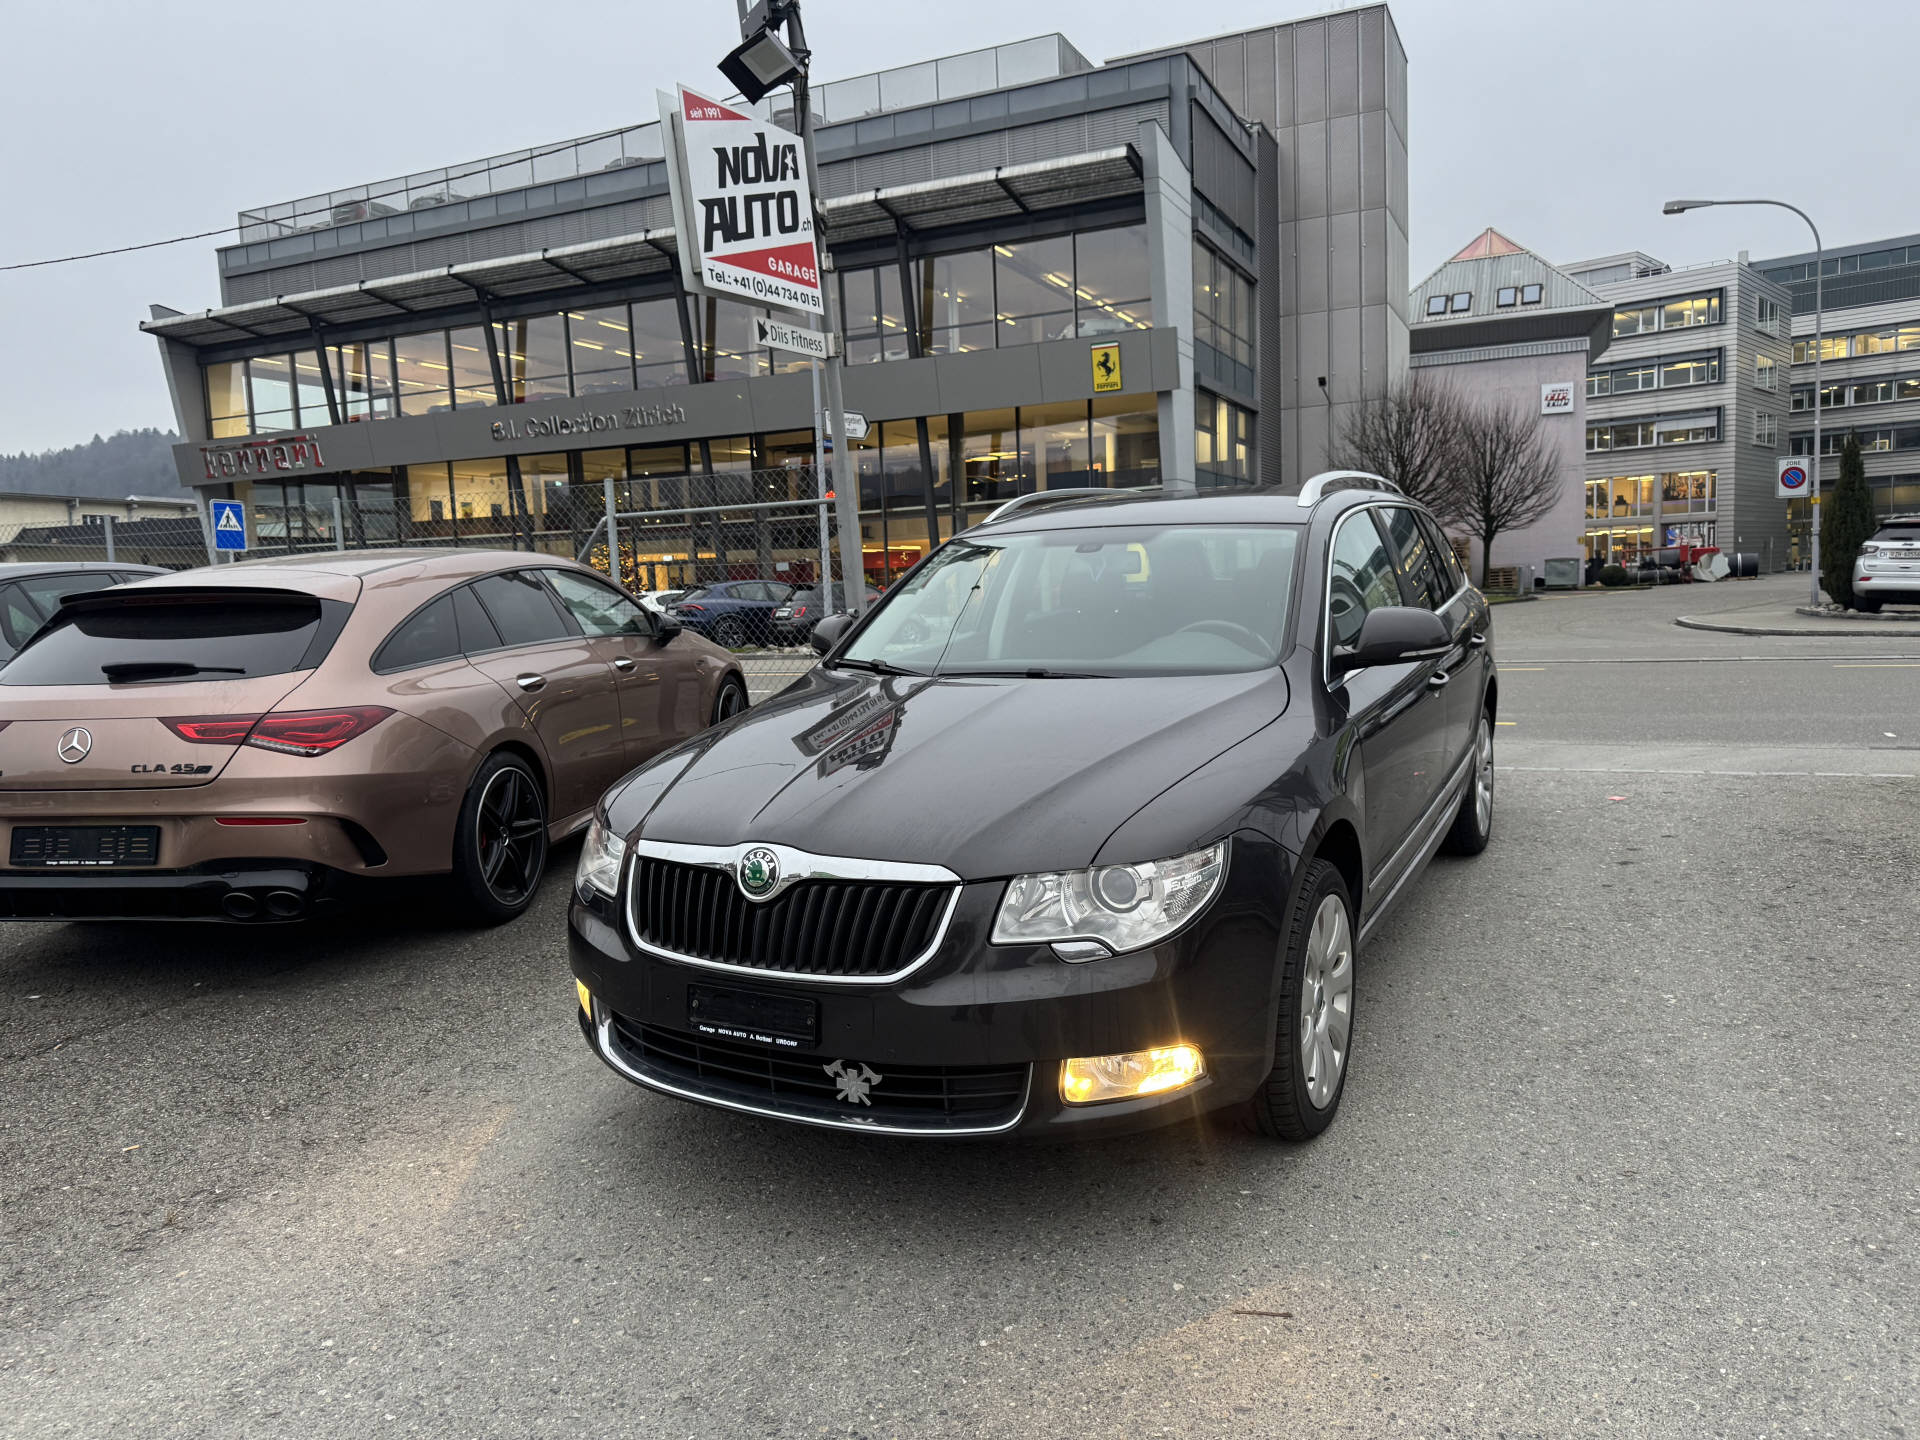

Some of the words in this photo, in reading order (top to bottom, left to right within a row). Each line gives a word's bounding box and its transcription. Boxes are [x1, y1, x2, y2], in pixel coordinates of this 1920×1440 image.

[689, 107, 703, 119] seit
[704, 107, 722, 119] 1991
[712, 132, 800, 189] NOVA
[697, 190, 800, 253] AUTO
[768, 257, 816, 283] GARAGE
[708, 268, 732, 285] Tel.:
[733, 277, 751, 290] +41
[781, 288, 798, 302] 734
[800, 292, 810, 305] 01
[811, 296, 820, 308] 51
[770, 325, 789, 345] Diis
[791, 330, 822, 352] Fitness
[525, 411, 618, 438] Collection
[622, 403, 686, 429] Zürich
[200, 433, 325, 479] Ferrari
[131, 764, 166, 773] CLA
[700, 1025, 715, 1034] Garage
[718, 1028, 732, 1037] NOVA
[733, 1028, 747, 1038] AUTO
